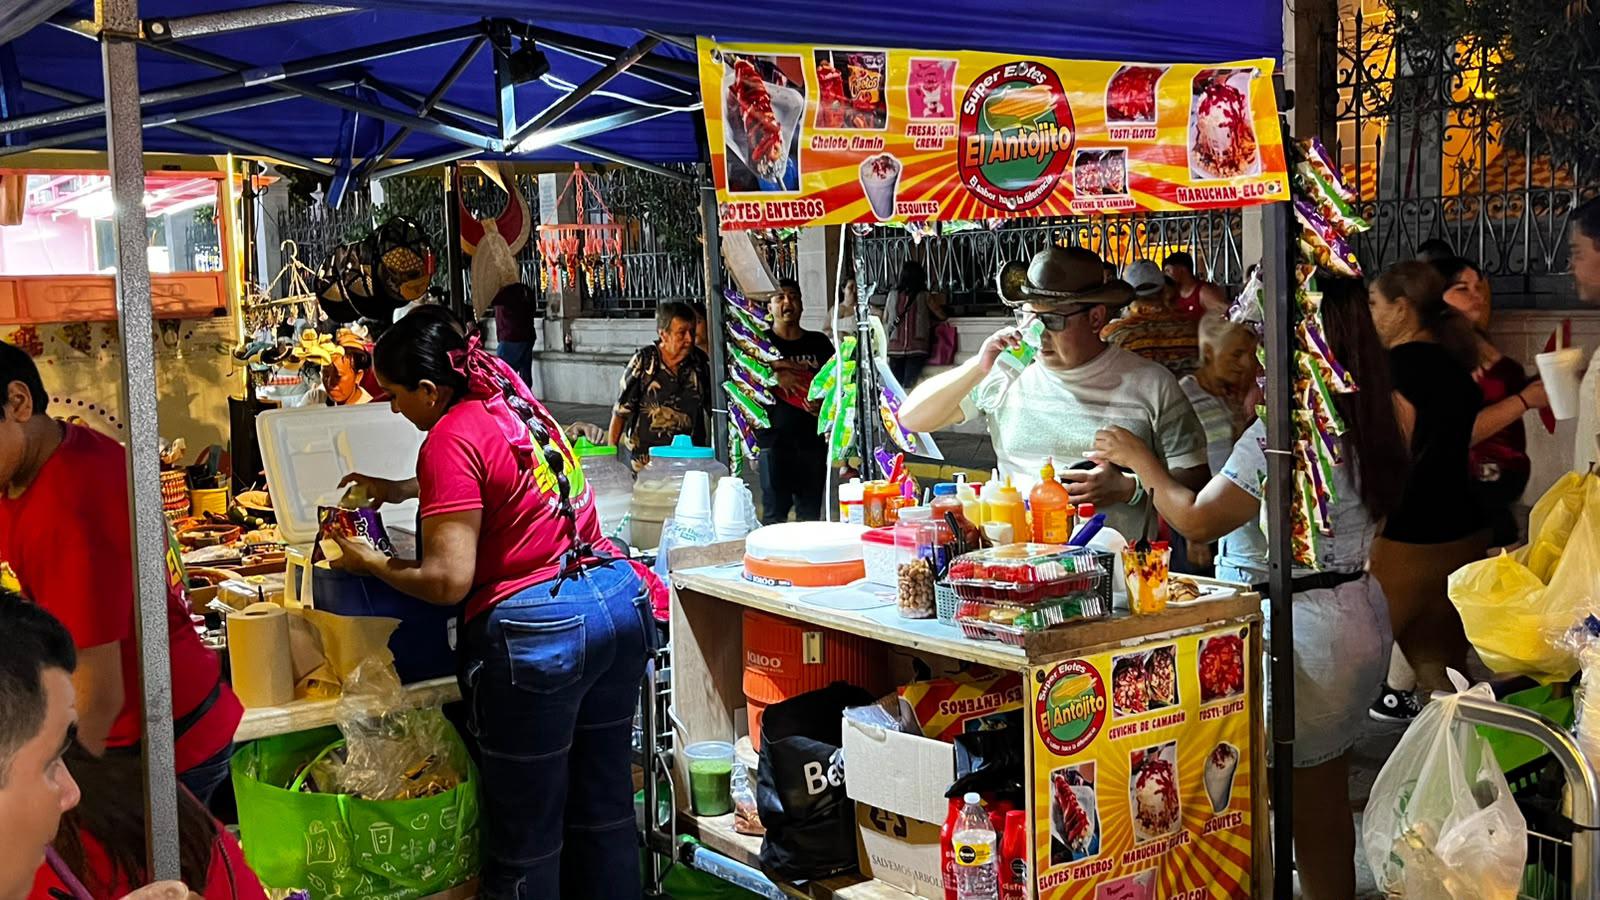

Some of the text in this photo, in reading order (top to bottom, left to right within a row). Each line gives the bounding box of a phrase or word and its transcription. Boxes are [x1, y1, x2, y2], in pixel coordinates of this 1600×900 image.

[964, 64, 1048, 115] Super Eotes
[907, 125, 937, 136] FRESAS
[915, 138, 943, 148] CREMA
[965, 122, 1071, 167] El Antojito
[976, 185, 996, 201] sabor
[766, 201, 824, 219] ENTEROS
[897, 202, 938, 215] ESQUITES
[1039, 662, 1087, 701] Super Elotes
[1040, 695, 1105, 733] El Antojito
[1109, 723, 1137, 740] CEVICHE
[1140, 720, 1149, 732] DE
[1039, 858, 1113, 890] ELOTES ENTEROS
